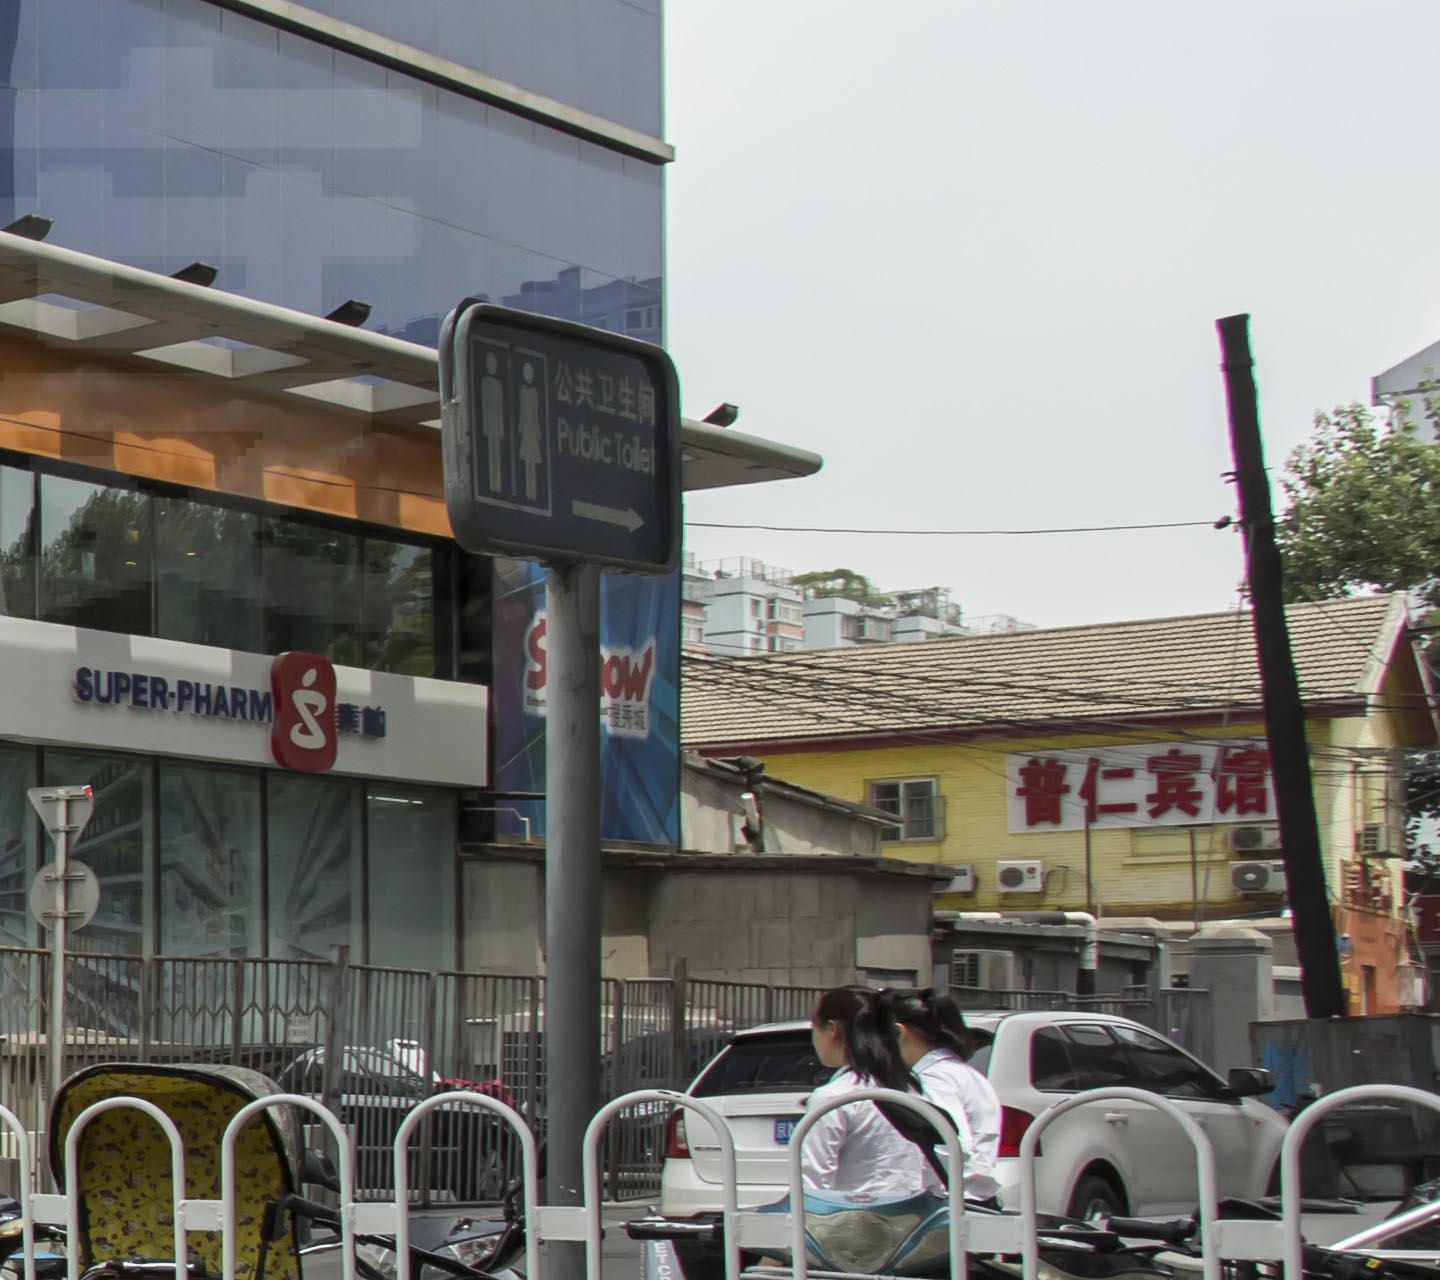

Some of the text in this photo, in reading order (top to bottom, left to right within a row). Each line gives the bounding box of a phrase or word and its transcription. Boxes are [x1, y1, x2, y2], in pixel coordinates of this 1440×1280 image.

[555, 360, 656, 429] 公共卫生间
[557, 416, 657, 478] Public Toilet
[75, 666, 272, 725] SUPER-PHARM
[1016, 744, 1276, 829] 普仁宾馆
